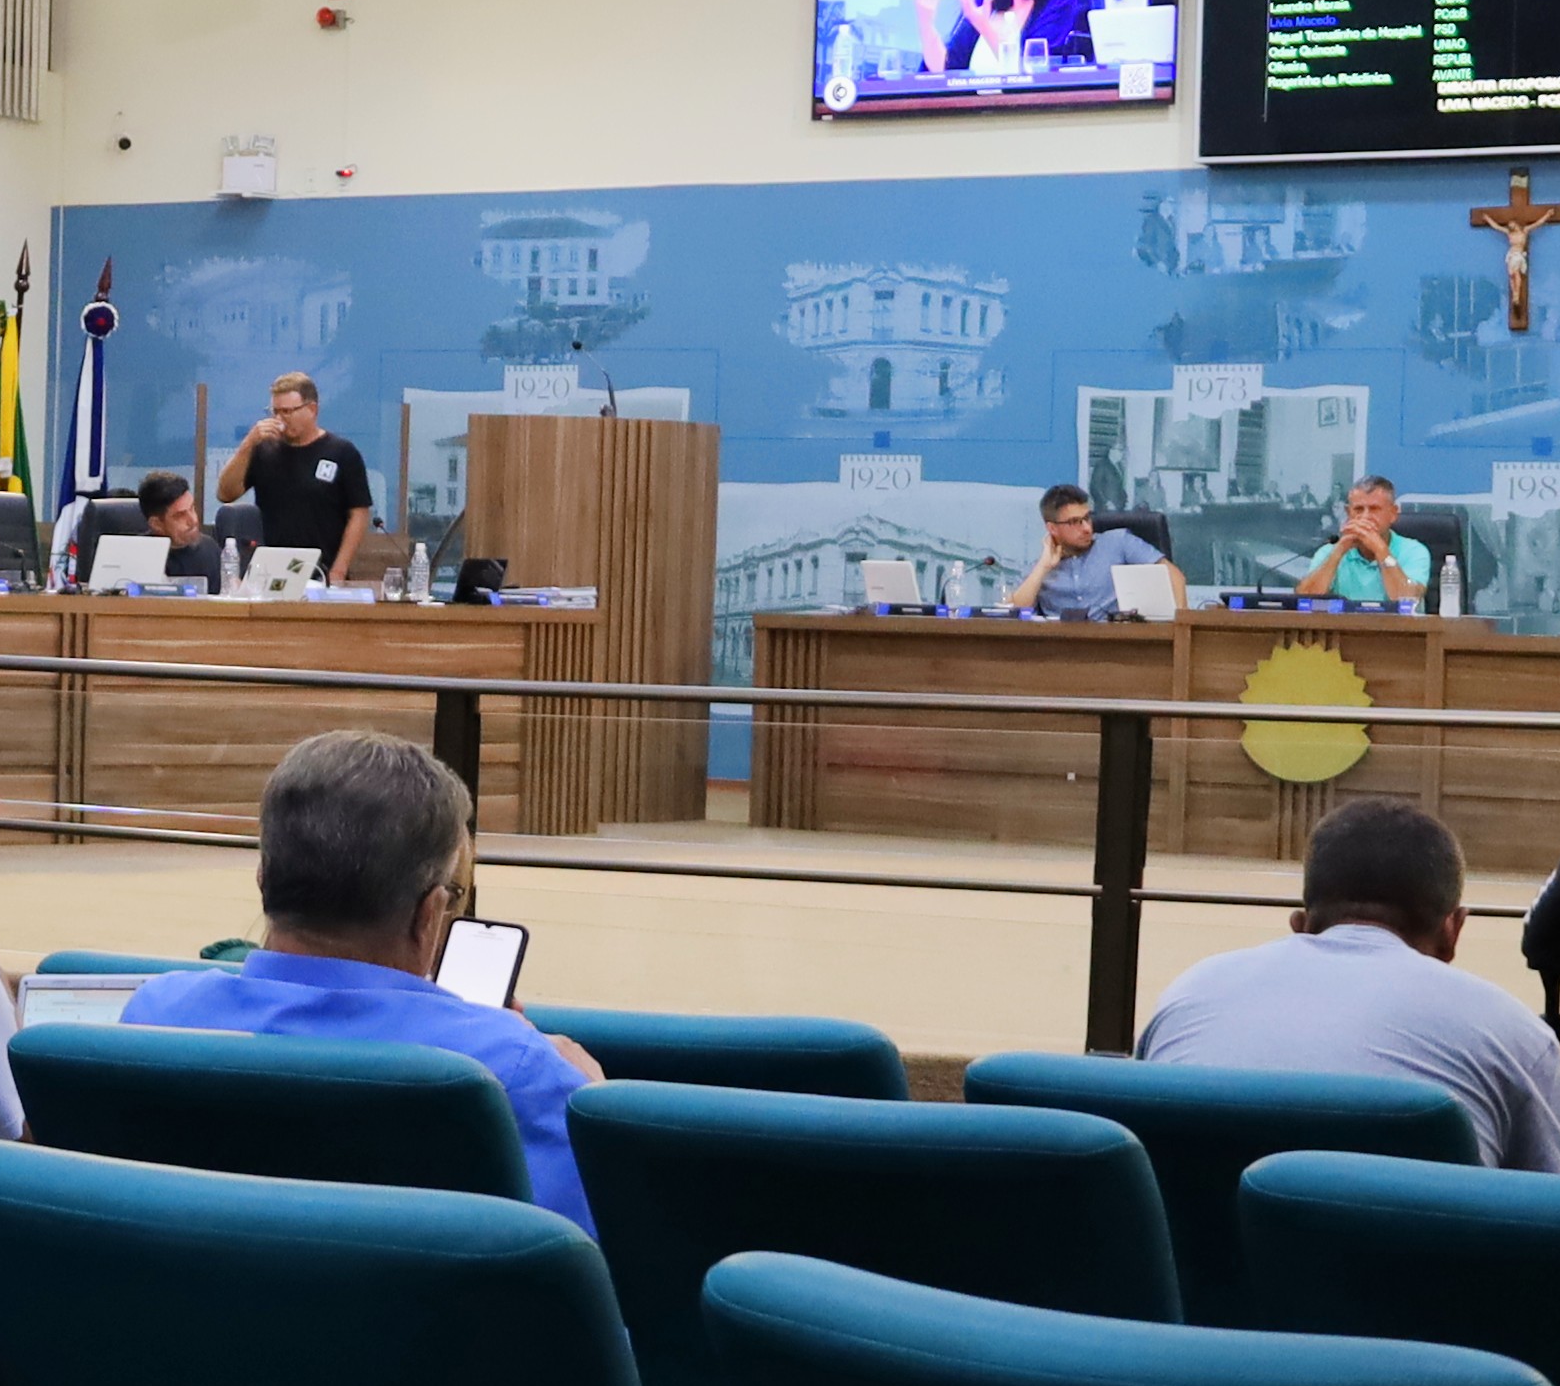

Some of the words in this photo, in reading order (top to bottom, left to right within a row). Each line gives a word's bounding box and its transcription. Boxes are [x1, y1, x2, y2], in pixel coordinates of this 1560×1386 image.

[1295, 15, 1337, 27] Macedo
[1433, 23, 1457, 37] PSD
[1432, 68, 1473, 82] AVANTE
[1471, 95, 1530, 111] MACEDO
[514, 377, 570, 399] 1920
[1187, 377, 1247, 401] 1973
[850, 467, 911, 491] 1920
